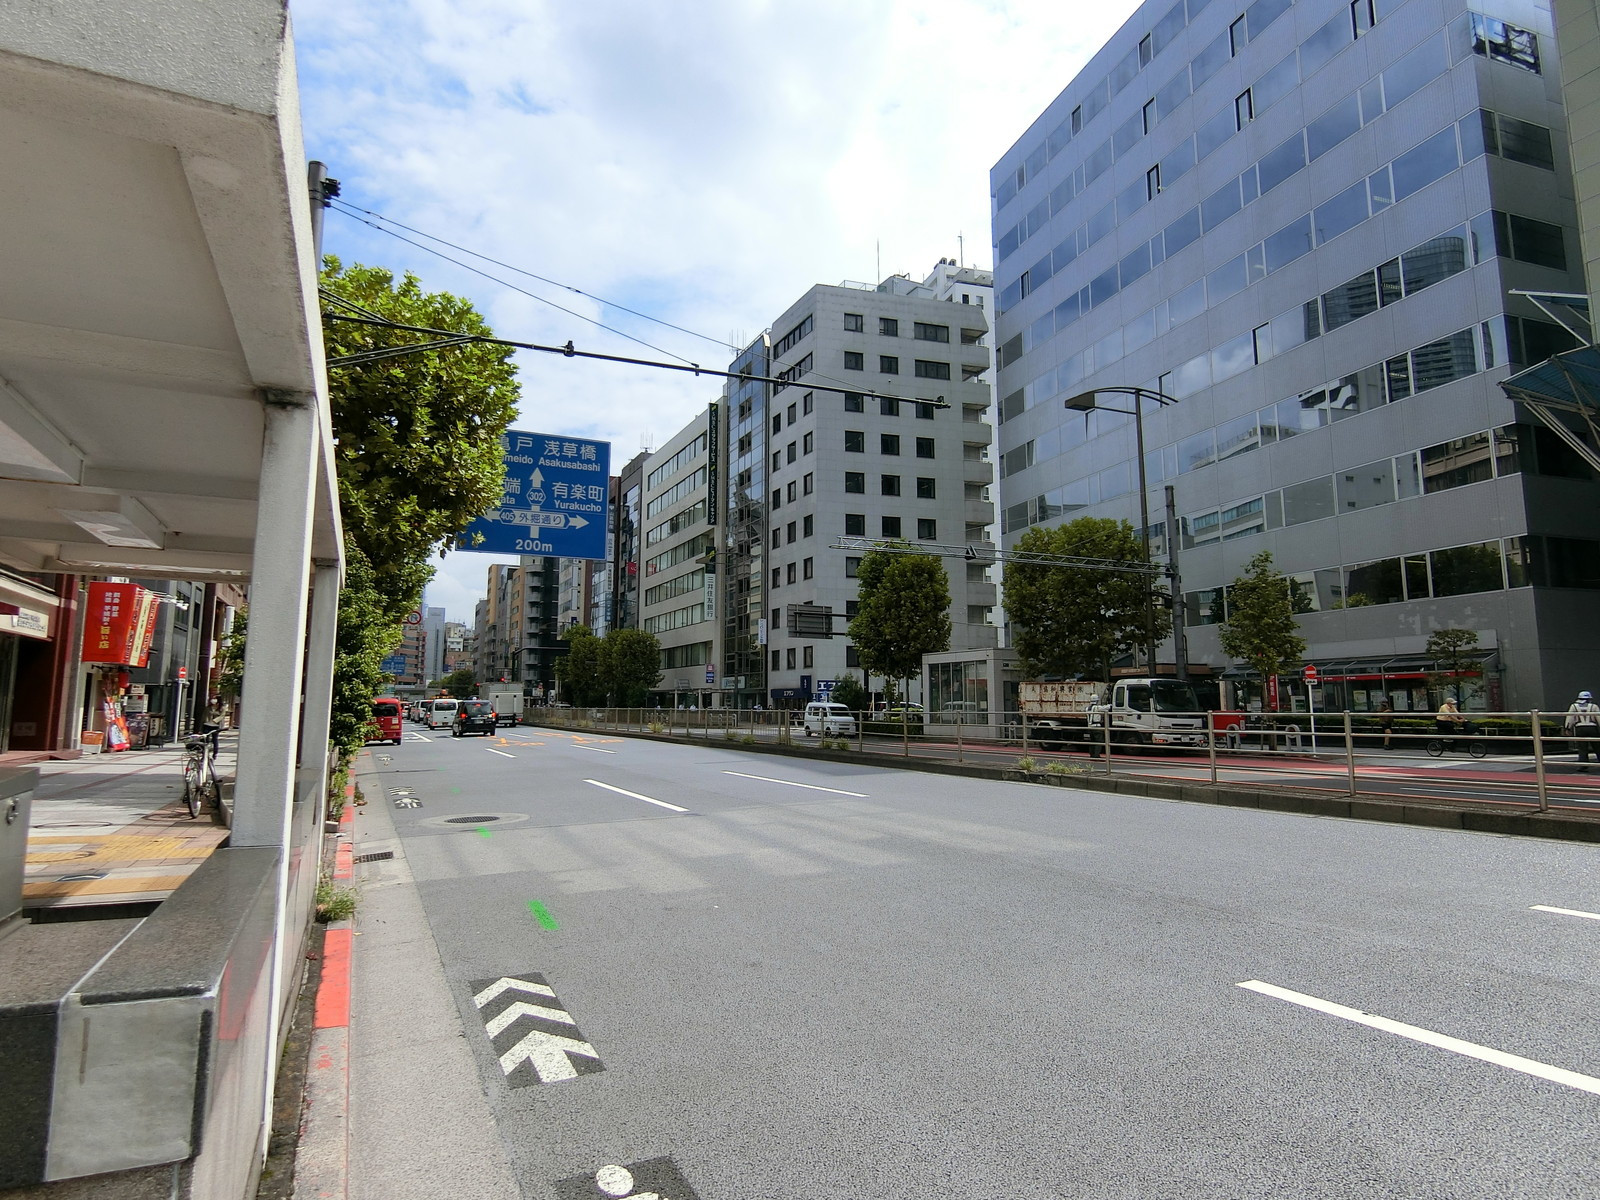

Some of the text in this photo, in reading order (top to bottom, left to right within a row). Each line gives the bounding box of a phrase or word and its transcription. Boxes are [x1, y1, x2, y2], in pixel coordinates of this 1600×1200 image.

[544, 439, 597, 461] 浅草橋
[502, 454, 601, 472] meido Asakusabashi
[502, 477, 604, 502] 端 有楽町
[529, 492, 544, 501] 302
[554, 500, 602, 512] Yurakucho
[500, 512, 562, 525] 405 外堀通り
[515, 539, 553, 552] 200m
